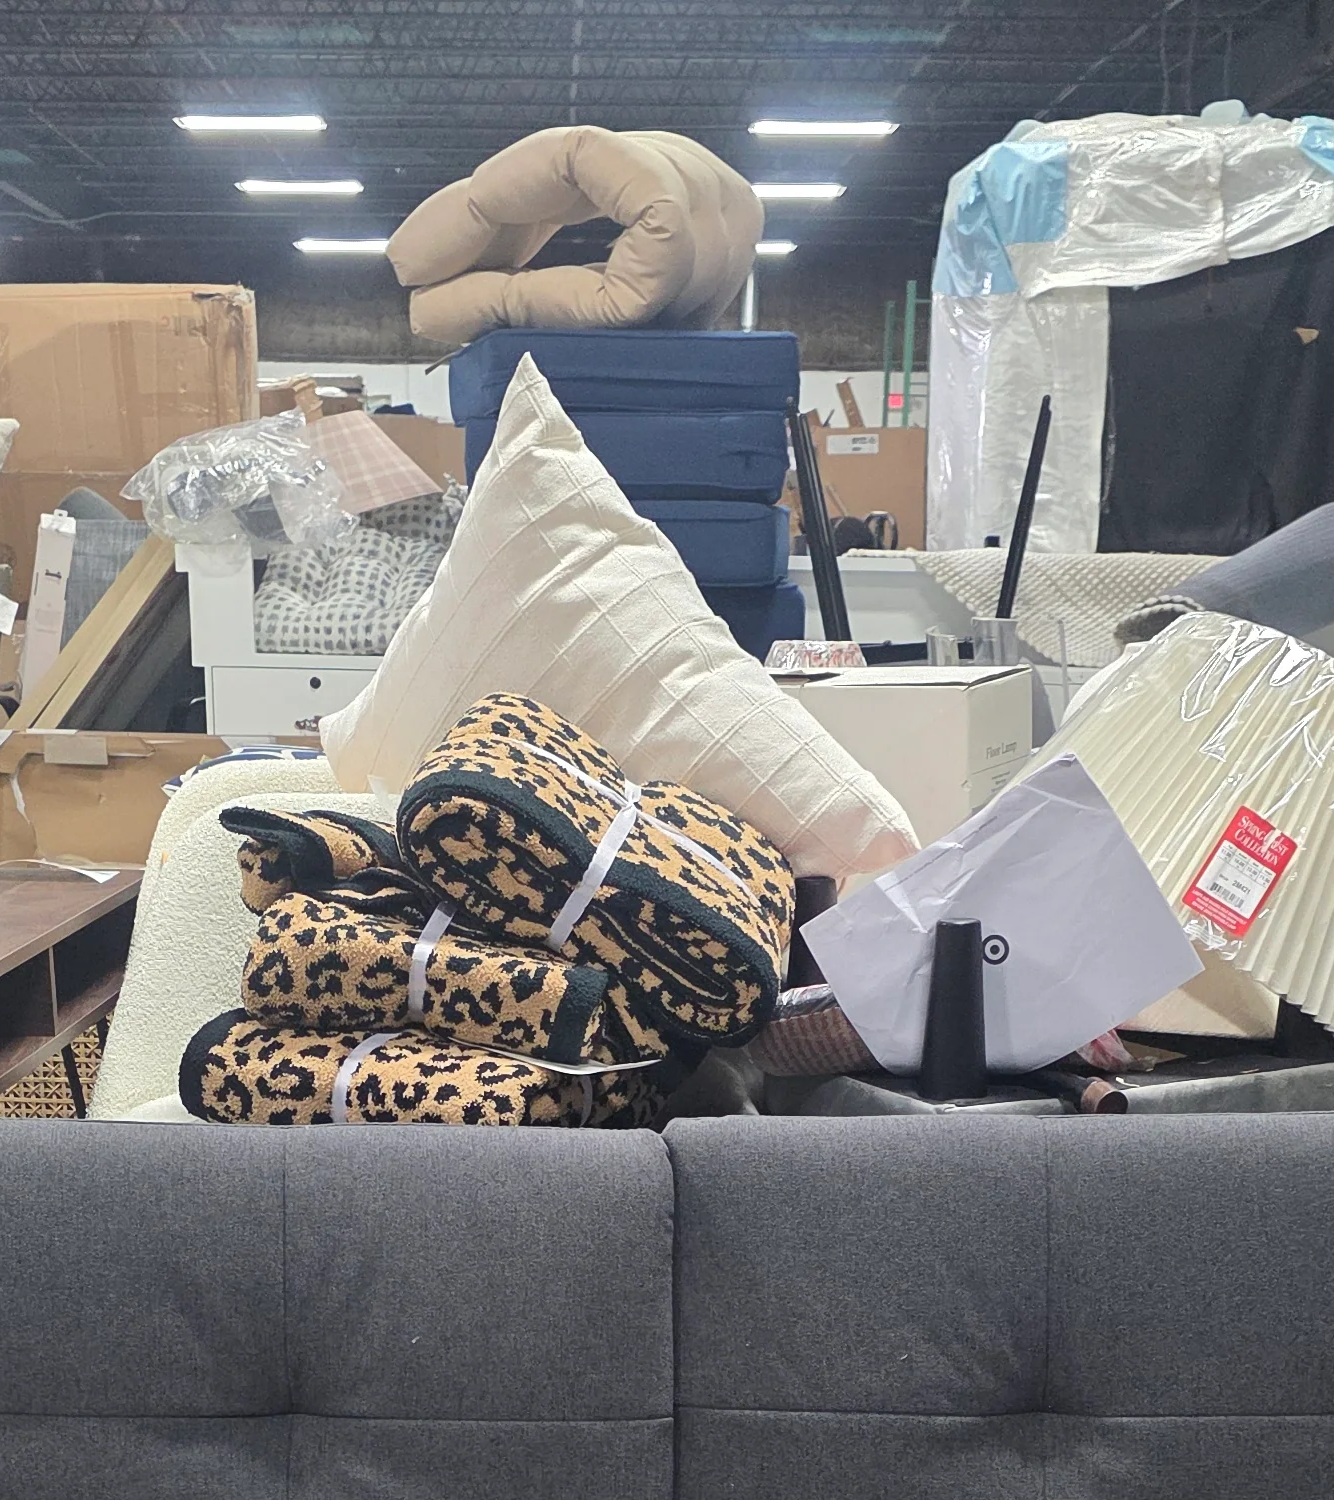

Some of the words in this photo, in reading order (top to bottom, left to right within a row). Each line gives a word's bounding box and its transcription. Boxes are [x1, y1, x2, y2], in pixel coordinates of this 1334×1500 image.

[986, 746, 1001, 759] Floor
[1001, 742, 1018, 755] Lamp
[1263, 829, 1289, 856] CEST
